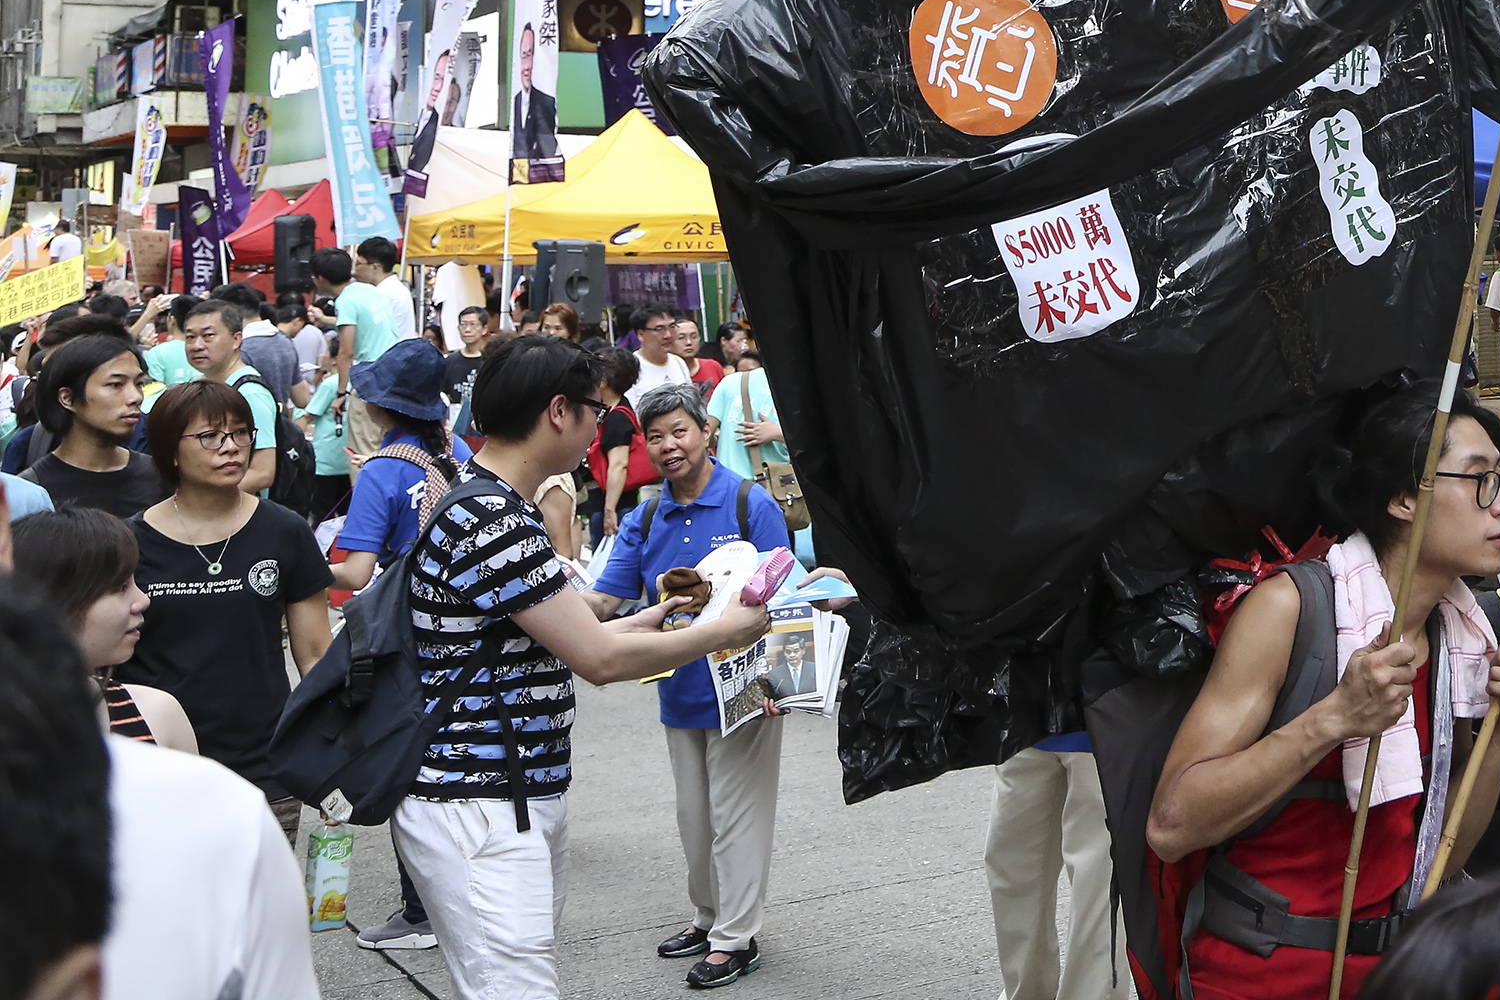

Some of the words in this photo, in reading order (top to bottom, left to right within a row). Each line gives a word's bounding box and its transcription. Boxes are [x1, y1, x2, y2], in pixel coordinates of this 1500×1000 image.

[1317, 119, 1386, 254] 未交代
[663, 240, 715, 251] CIVIC
[1027, 258, 1132, 336] 未交代
